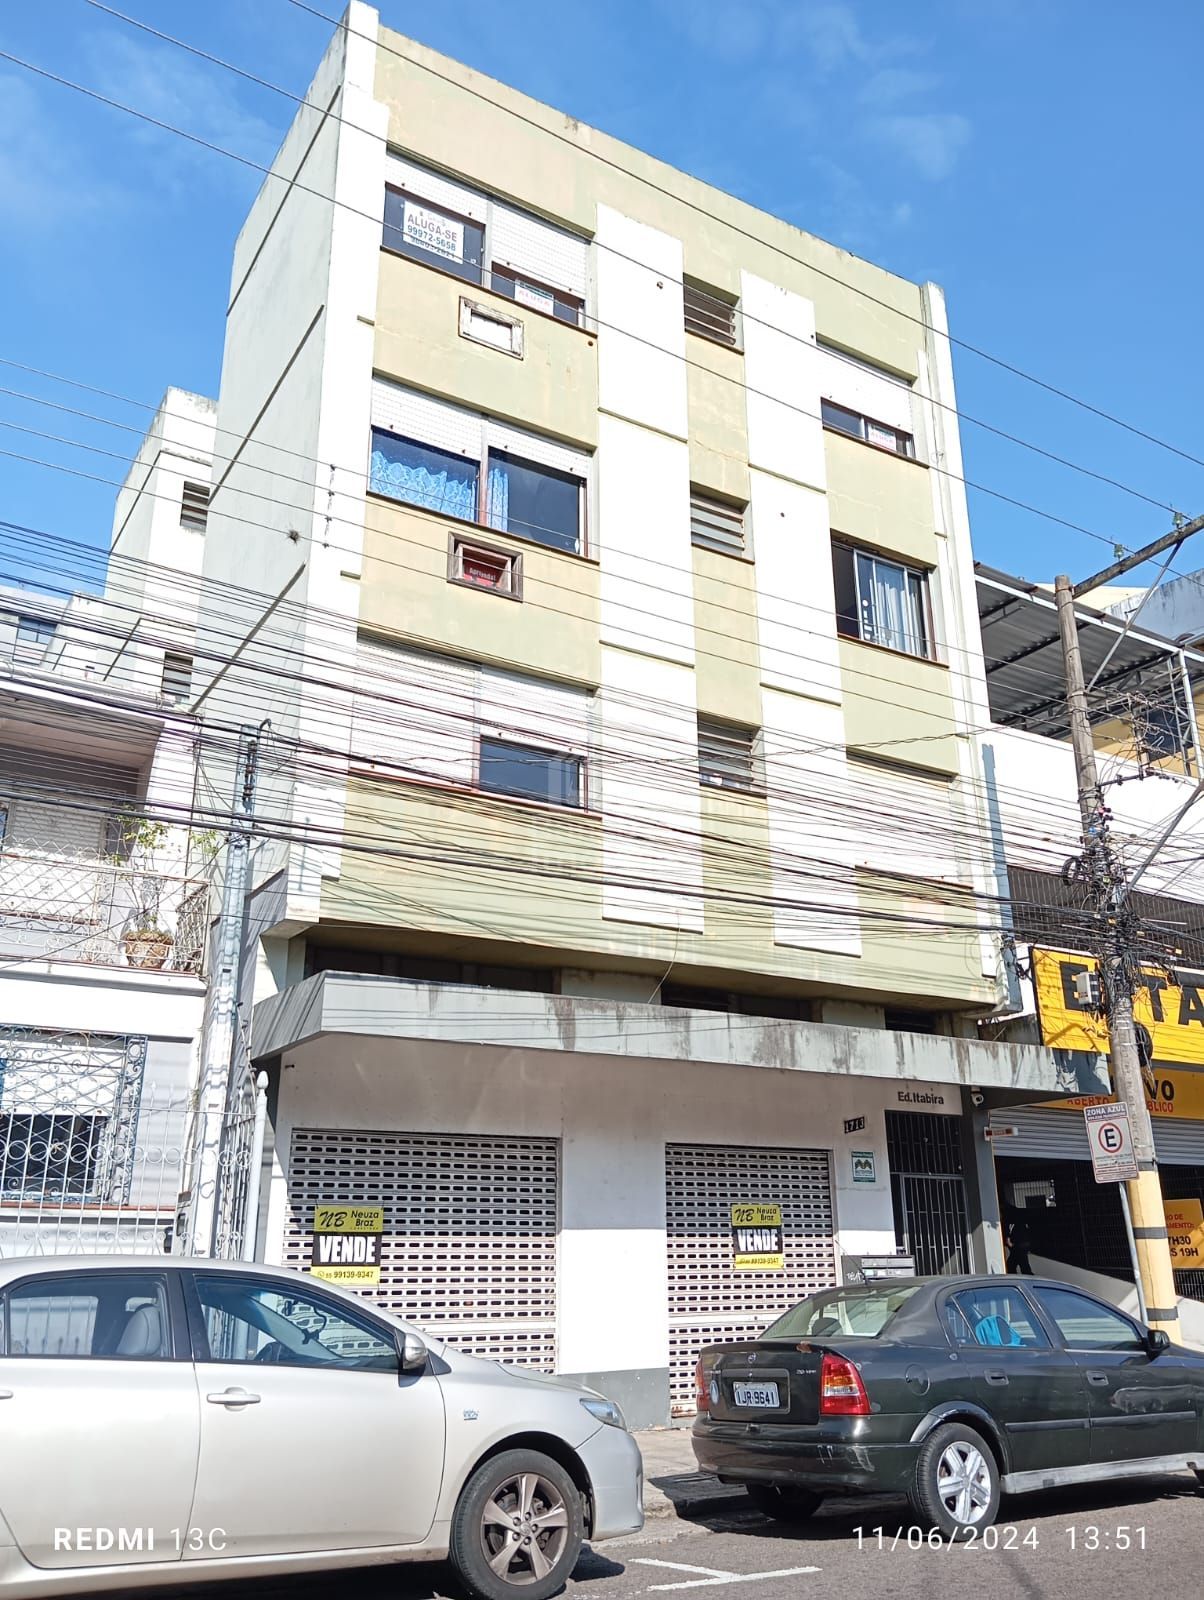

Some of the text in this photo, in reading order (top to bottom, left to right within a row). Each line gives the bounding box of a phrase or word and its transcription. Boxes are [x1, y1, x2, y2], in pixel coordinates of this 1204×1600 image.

[408, 213, 457, 242] ALUGA-SE
[1086, 1108, 1107, 1117] ZONA
[1107, 1105, 1126, 1114] AZUL
[1147, 1101, 1174, 1113] BLICO
[1103, 1128, 1117, 1148] E
[351, 1210, 379, 1219] Neuza
[756, 1207, 777, 1215] Neuza
[319, 1211, 348, 1228] NB
[355, 1218, 374, 1227] Braz
[736, 1228, 779, 1252] VENDE
[319, 1235, 377, 1263] VENDE
[1179, 1247, 1199, 1257] 19H
